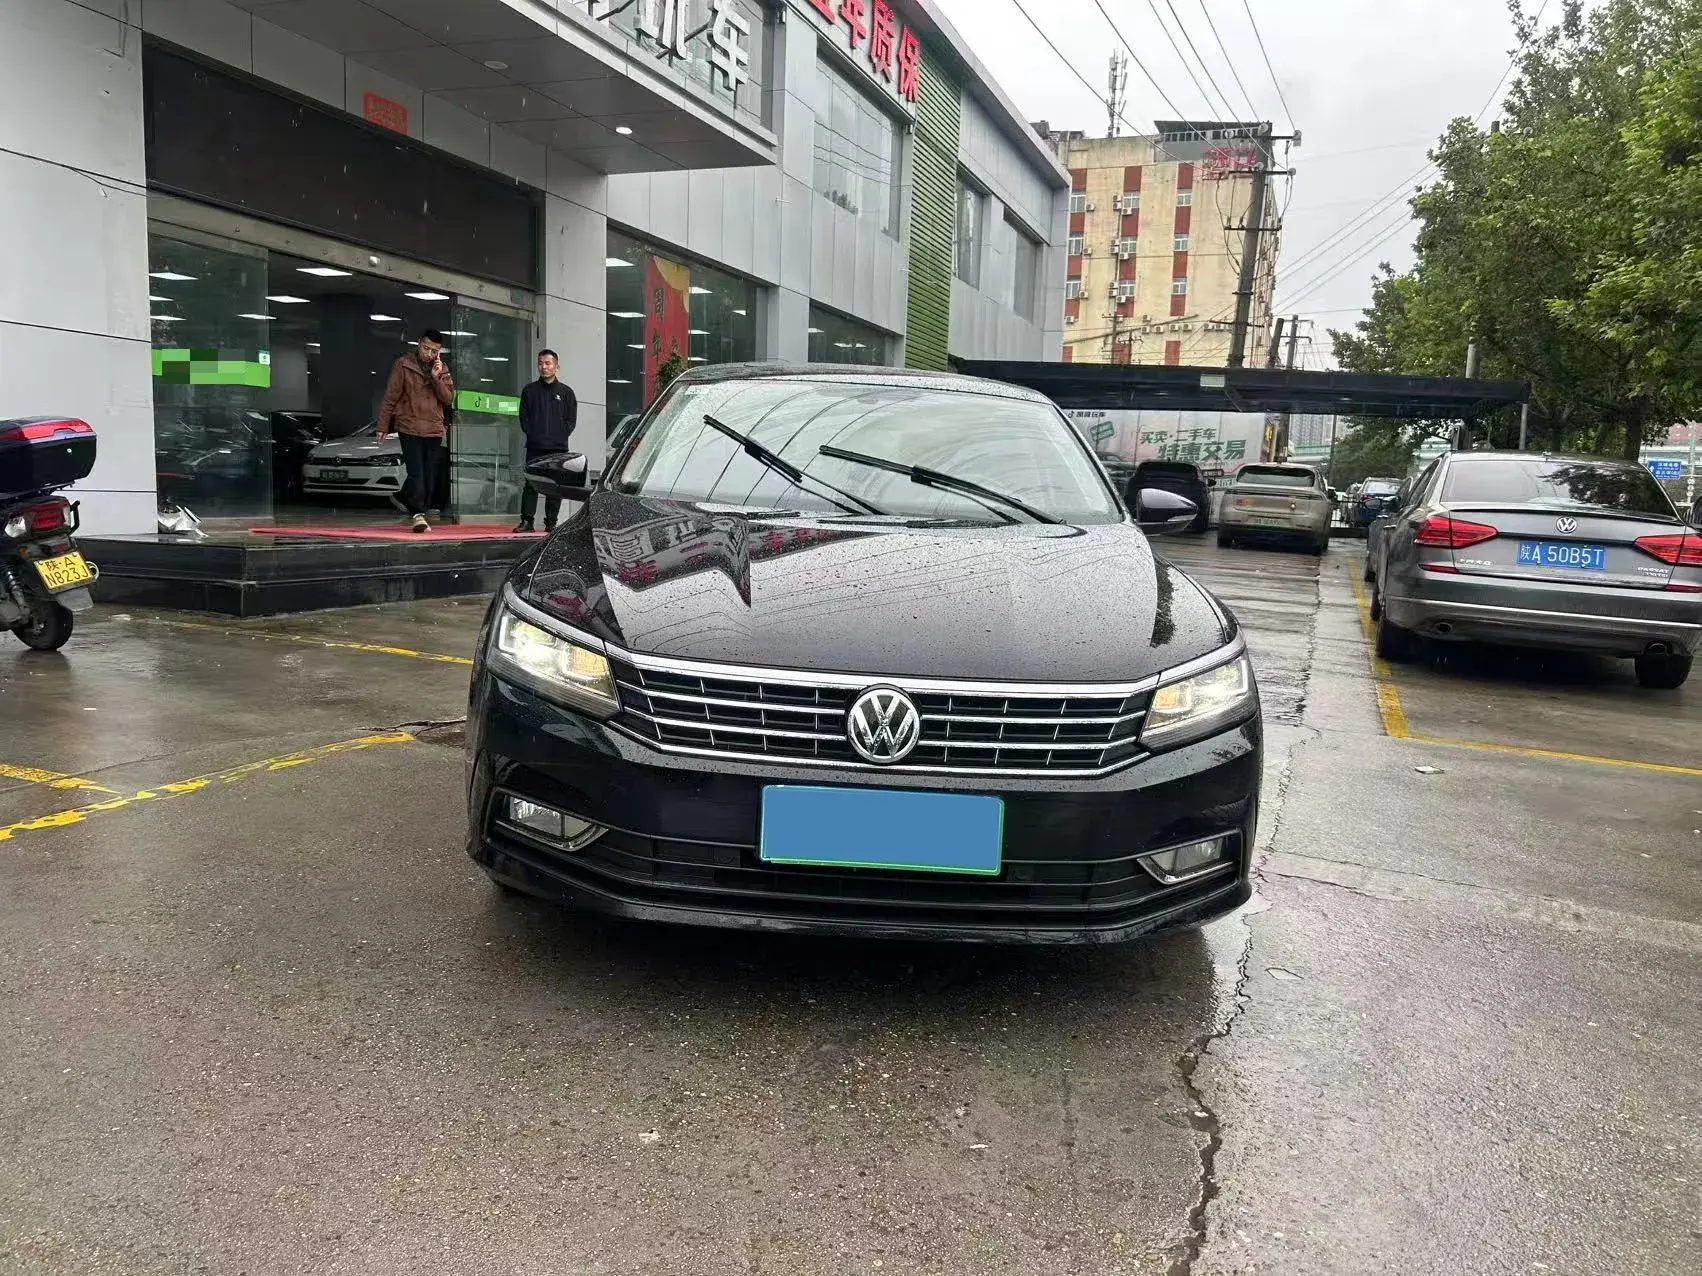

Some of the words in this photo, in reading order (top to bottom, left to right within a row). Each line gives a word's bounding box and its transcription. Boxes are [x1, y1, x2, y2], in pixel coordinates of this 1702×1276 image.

[805, 0, 918, 103] 年质保
[1158, 439, 1246, 461] 特惠交易
[45, 565, 89, 586] N823J
